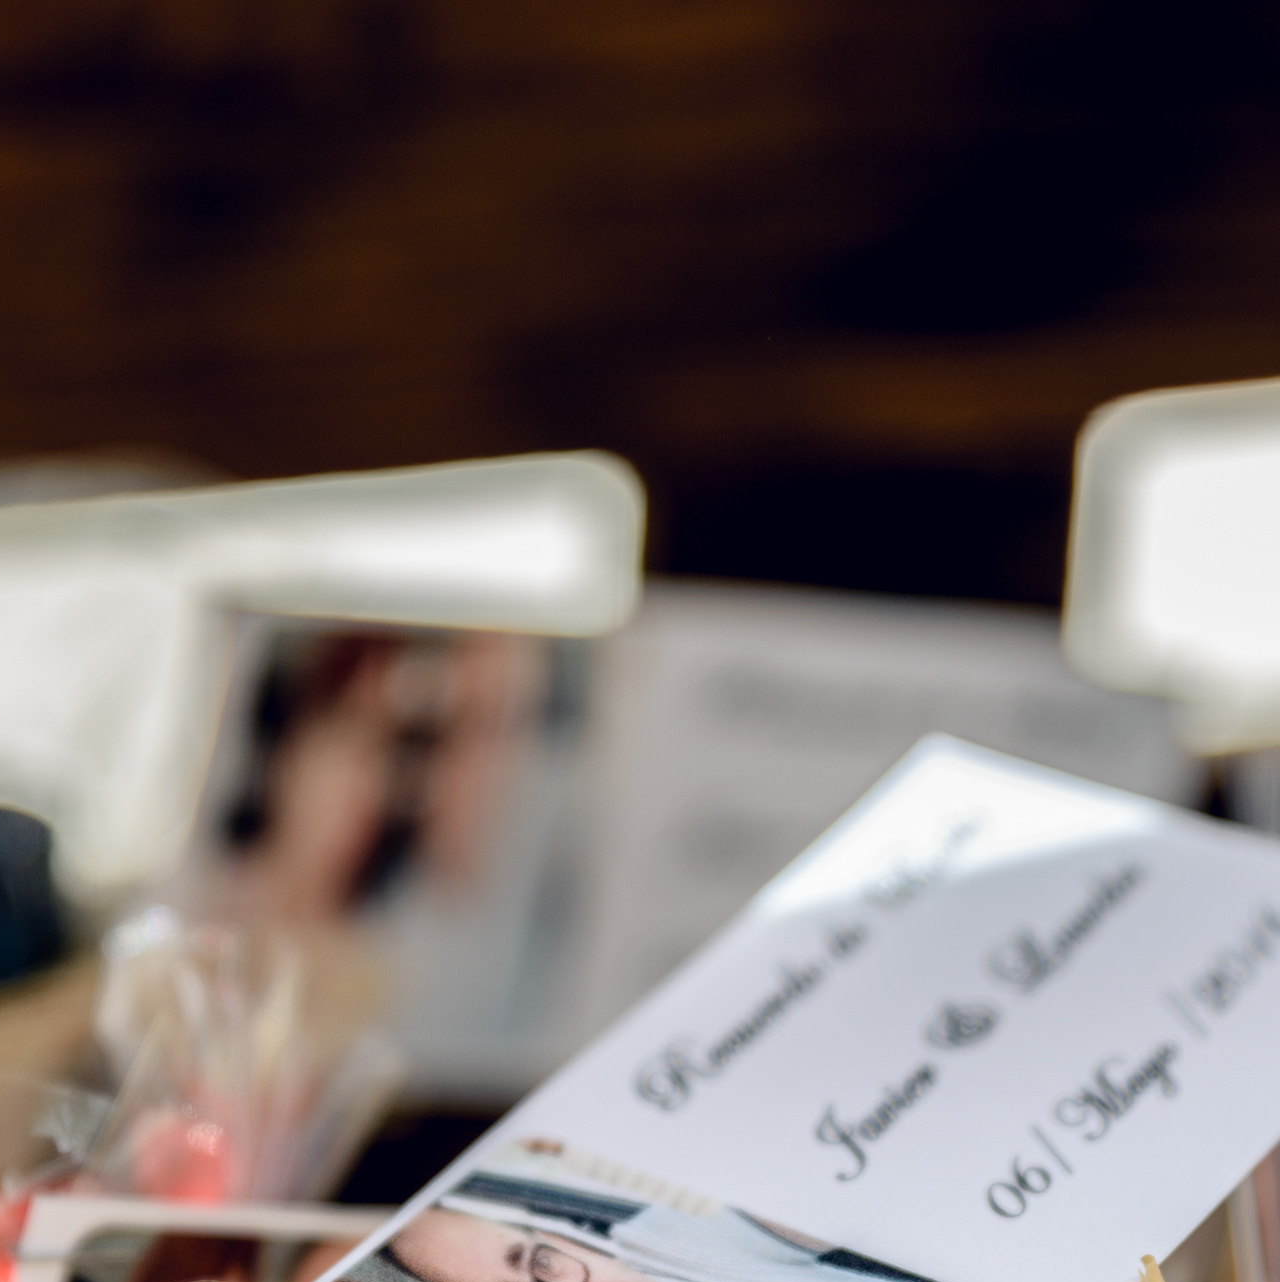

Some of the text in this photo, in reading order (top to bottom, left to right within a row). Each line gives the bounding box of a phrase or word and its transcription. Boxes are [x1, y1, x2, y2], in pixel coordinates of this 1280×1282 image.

[815, 1062, 938, 1182] Javier
[925, 1000, 1001, 1050] &
[1054, 1040, 1180, 1142] Mayo
